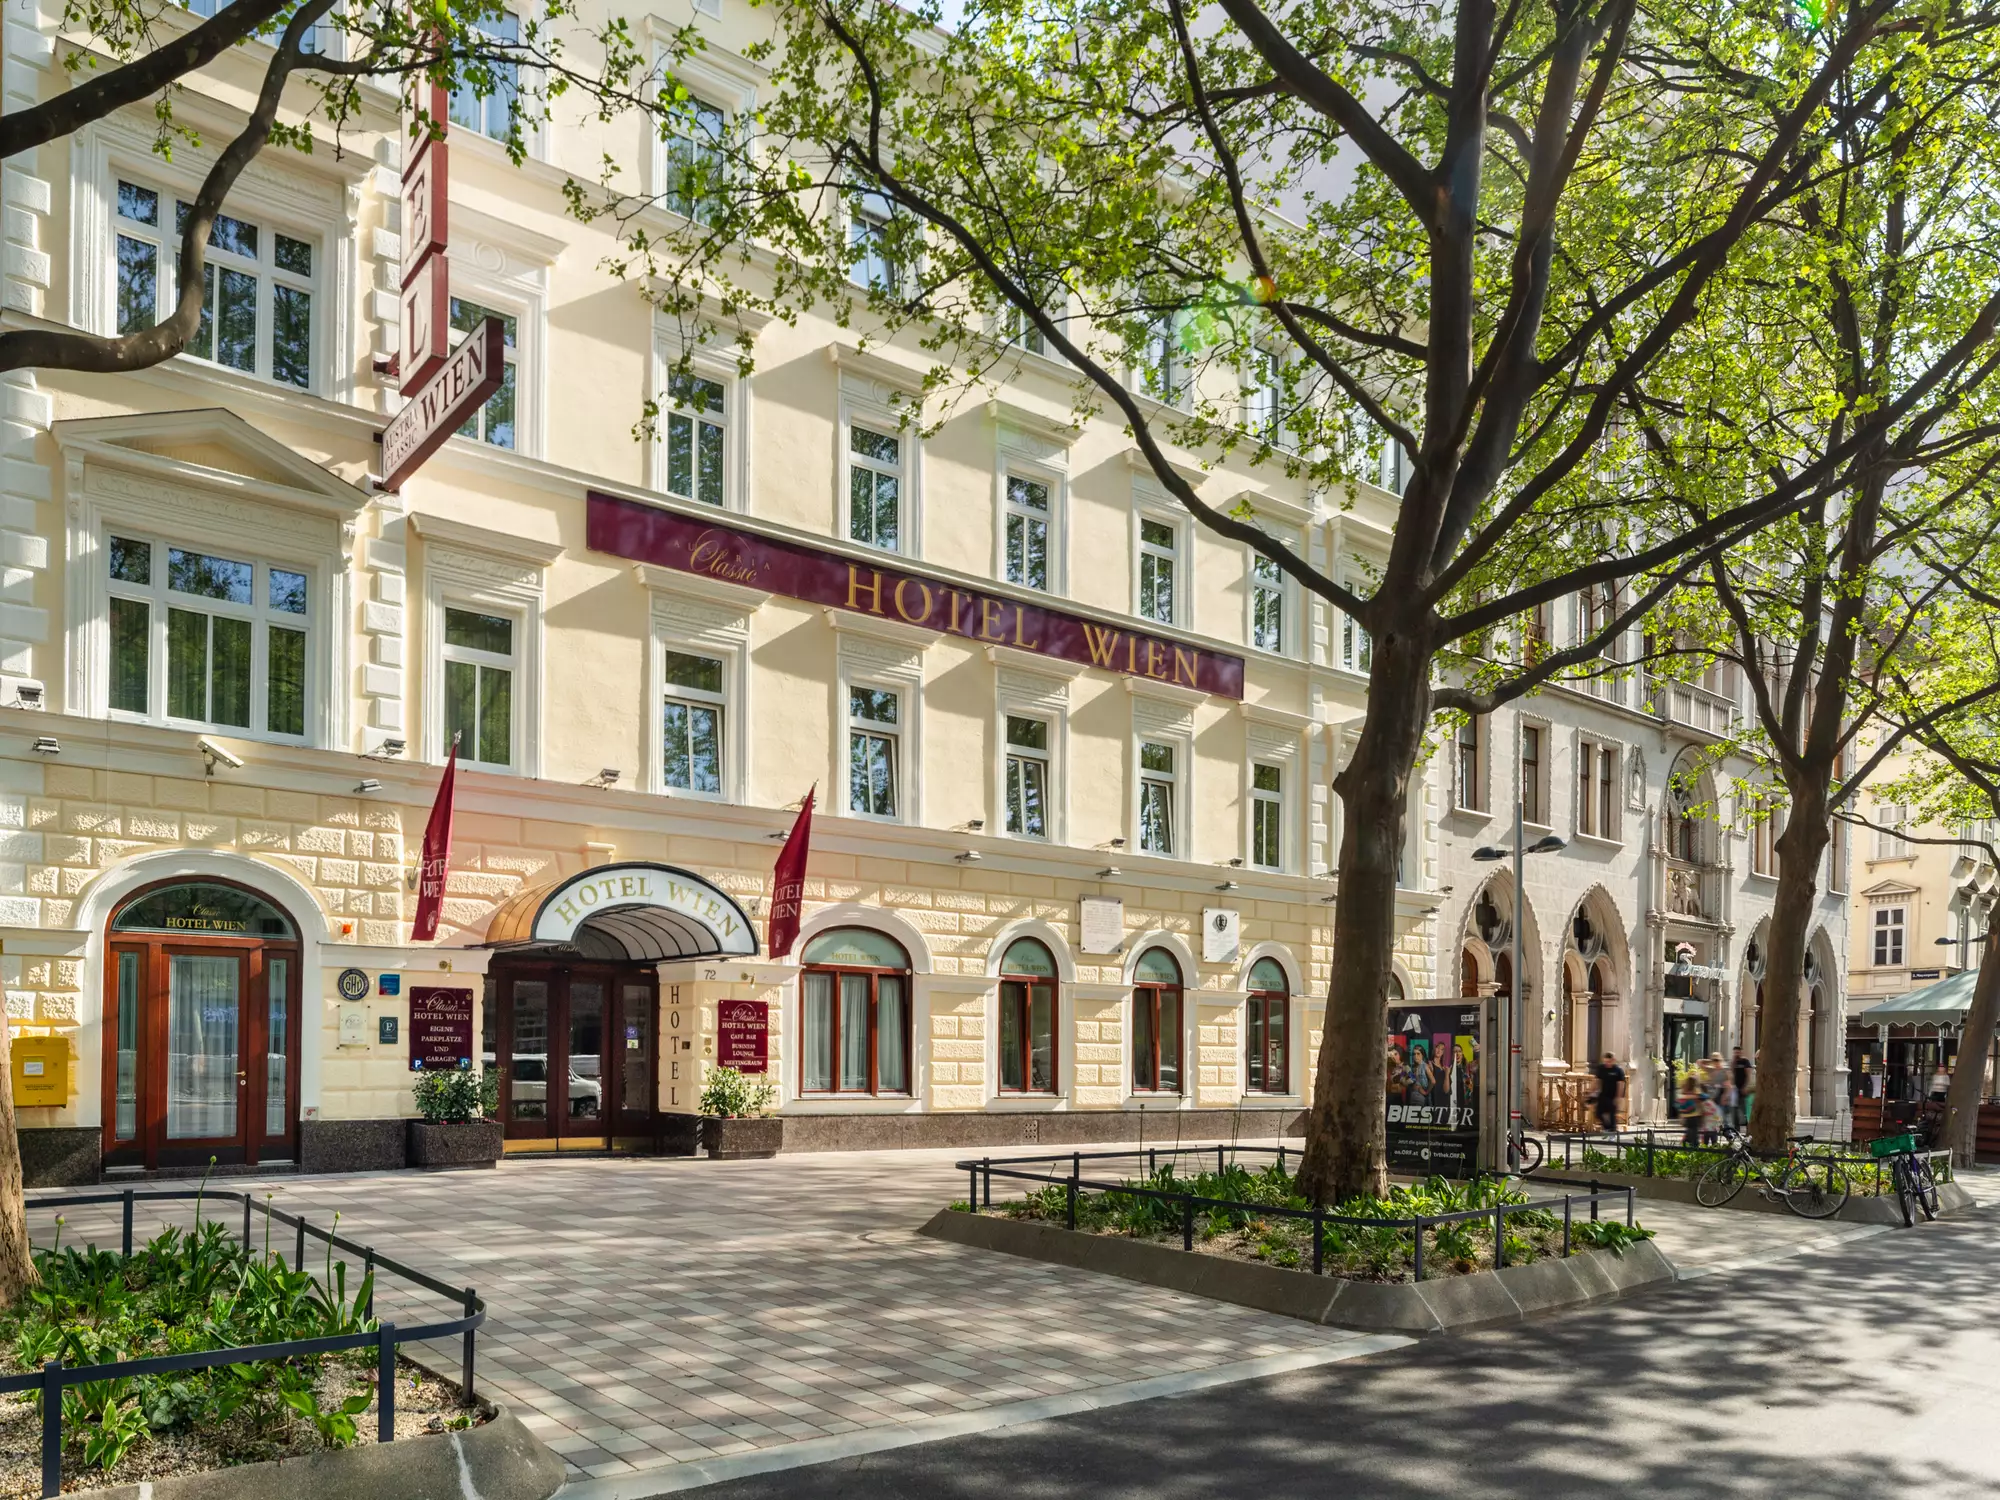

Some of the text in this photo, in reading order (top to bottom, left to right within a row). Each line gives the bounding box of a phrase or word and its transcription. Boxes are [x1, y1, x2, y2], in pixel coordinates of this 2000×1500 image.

[384, 332, 484, 454] AUSTRIA WIEN
[384, 428, 418, 472] CLASSIC
[690, 540, 757, 582] Classic
[845, 562, 1201, 688] HOTEL WIEN
[555, 876, 740, 938] HOTEL WIEN
[166, 917, 246, 931] HOTEL WIEN
[831, 952, 881, 962] HOTEL WIEN
[704, 969, 716, 980] 72
[427, 996, 458, 1011] Classic
[414, 1012, 444, 1020] HOTEL
[670, 985, 680, 1105] HOTEL
[414, 1060, 422, 1068] P
[1387, 1104, 1474, 1126] BIESTER
